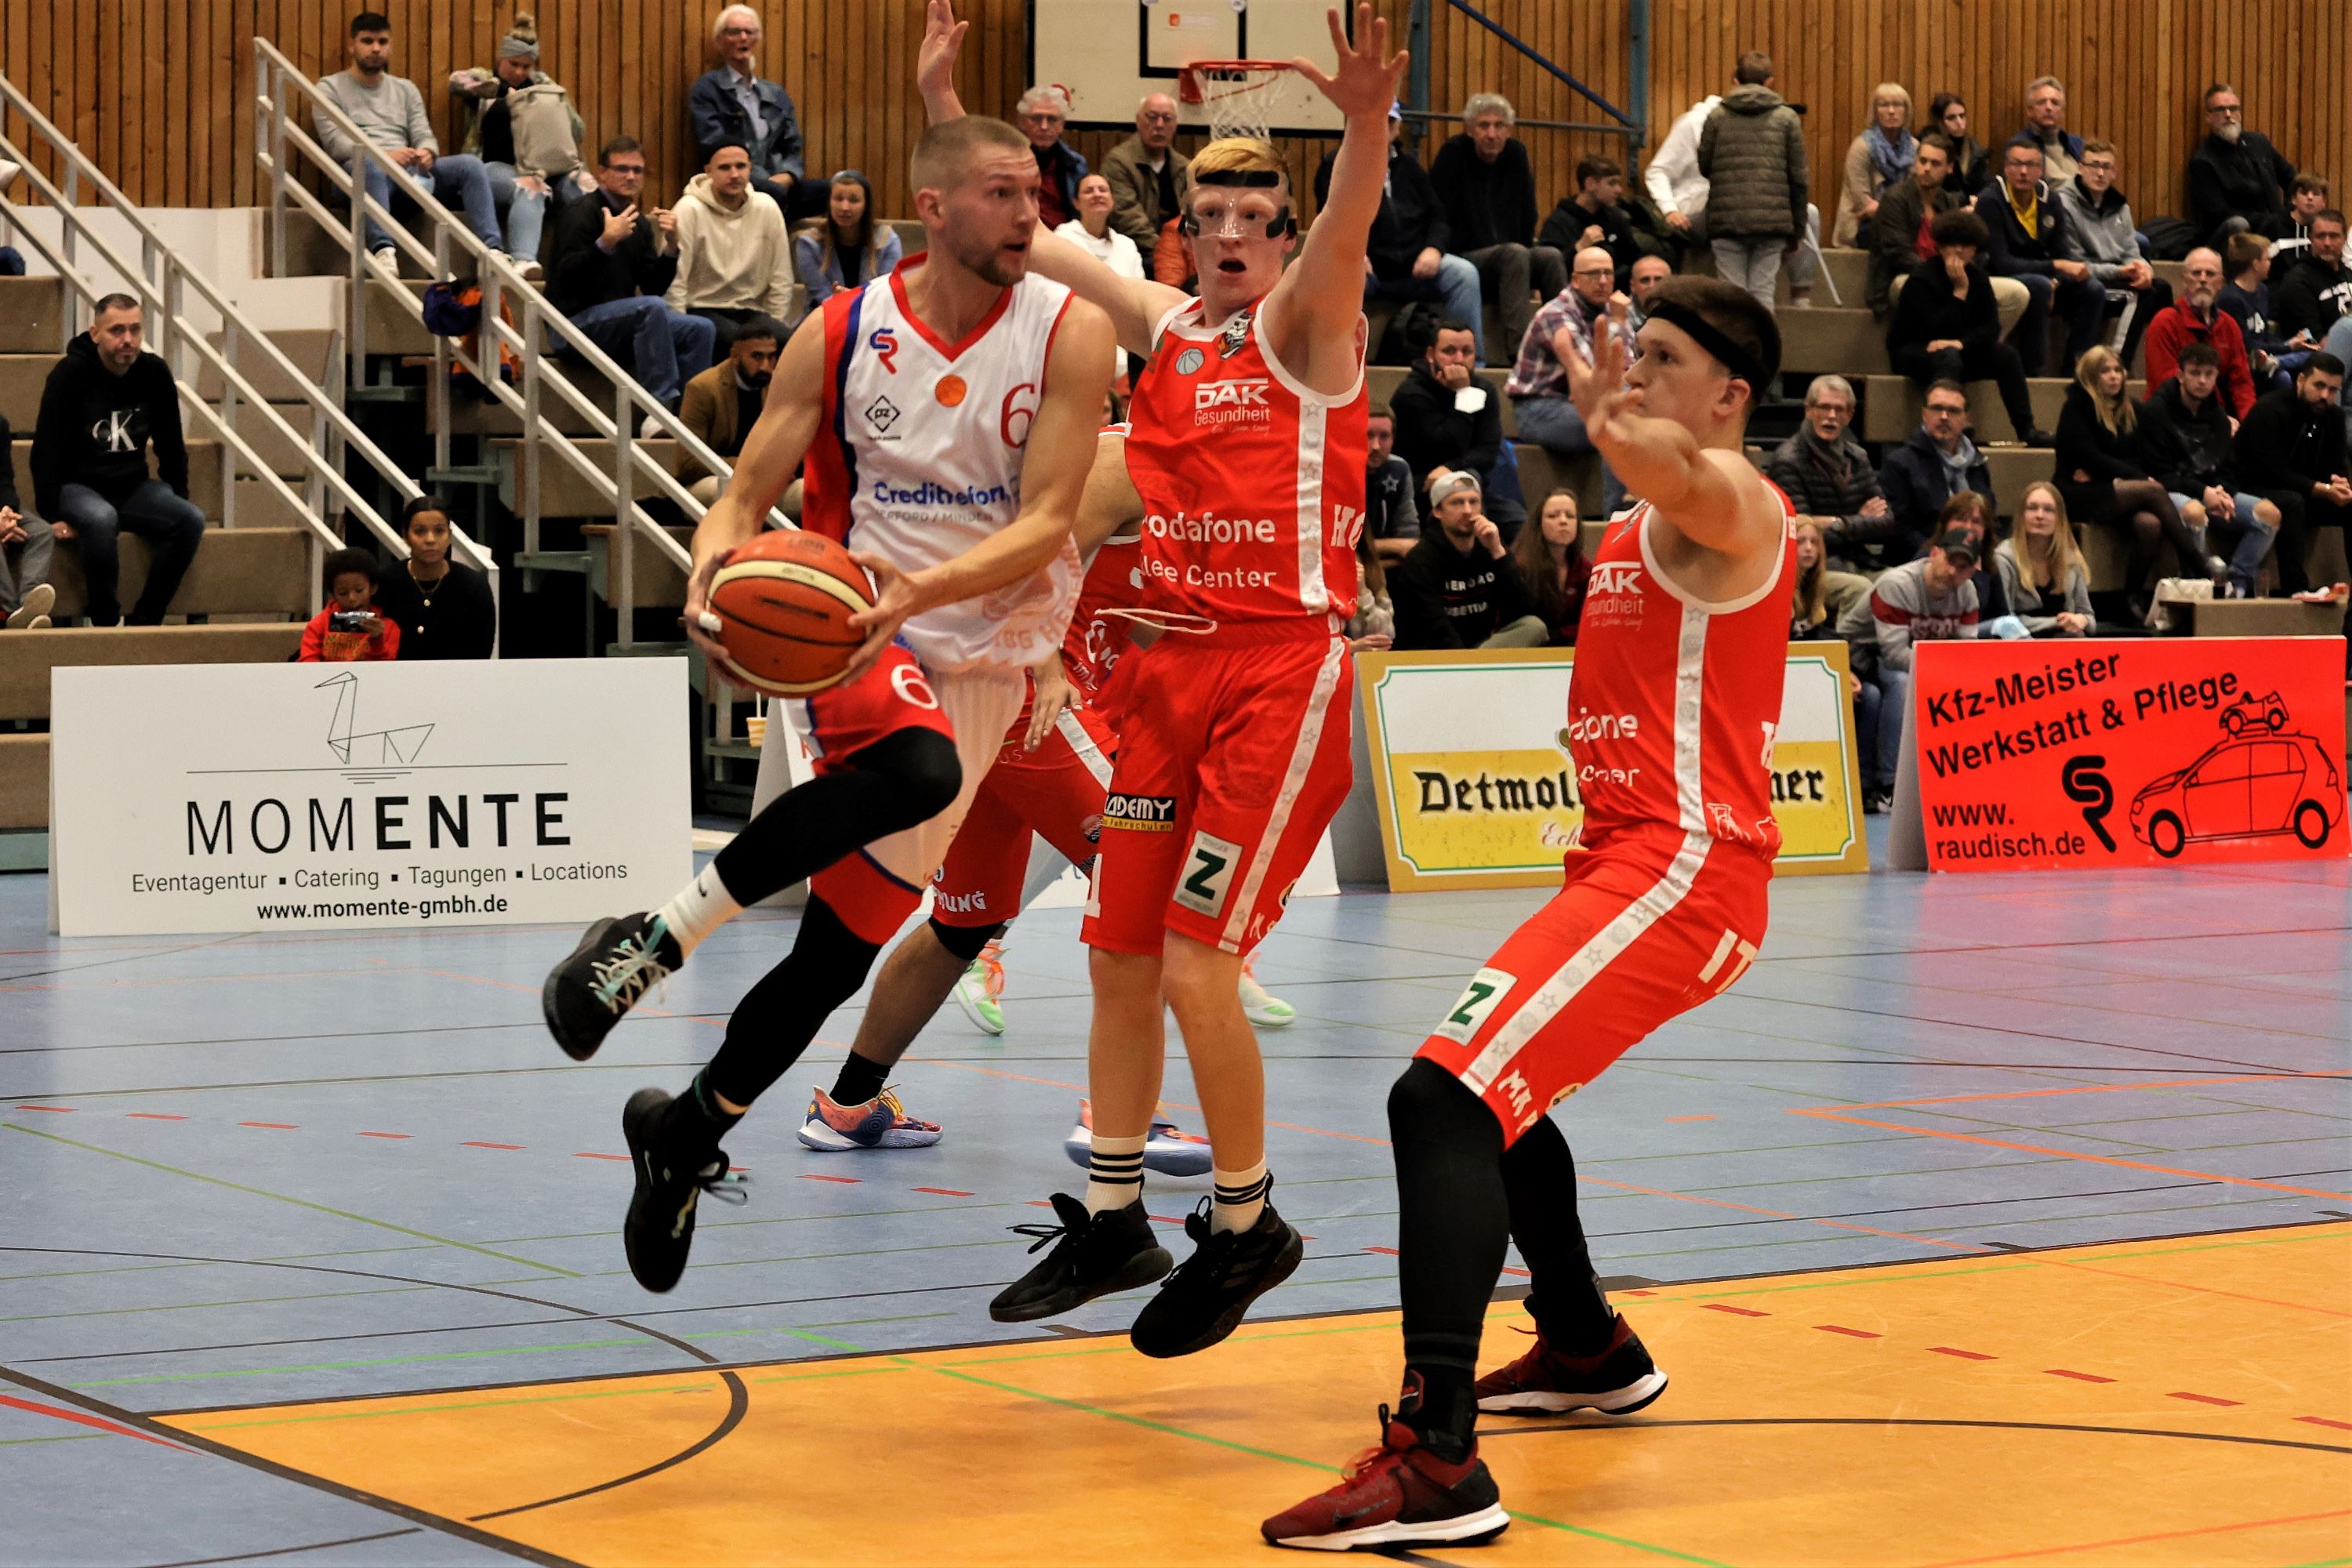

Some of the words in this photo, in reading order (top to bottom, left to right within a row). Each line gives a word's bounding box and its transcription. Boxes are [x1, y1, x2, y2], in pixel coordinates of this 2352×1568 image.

[1195, 378, 1269, 409] DAK
[1000, 383, 1035, 448] 6
[1194, 405, 1271, 426] Gesundheit
[1186, 564, 1277, 588] Center
[891, 664, 939, 710] 6
[1927, 652, 2121, 728] Kfz-Meister
[1926, 709, 2092, 779] Werkstatt
[2101, 699, 2125, 731] &
[2133, 672, 2238, 720] Pflege
[187, 792, 572, 855] MOMENTE
[1105, 793, 1174, 821] ADEMY
[1932, 804, 2015, 828] www.
[1936, 831, 2086, 860] raudisch.de
[132, 873, 267, 895] Eventagentur
[295, 868, 379, 891] Catering
[408, 866, 506, 888] Tagungen
[531, 861, 628, 881] Locations
[1184, 848, 1228, 901] Z
[256, 894, 508, 920] www.momente-gmbh.de
[1448, 982, 1496, 1025] Z
